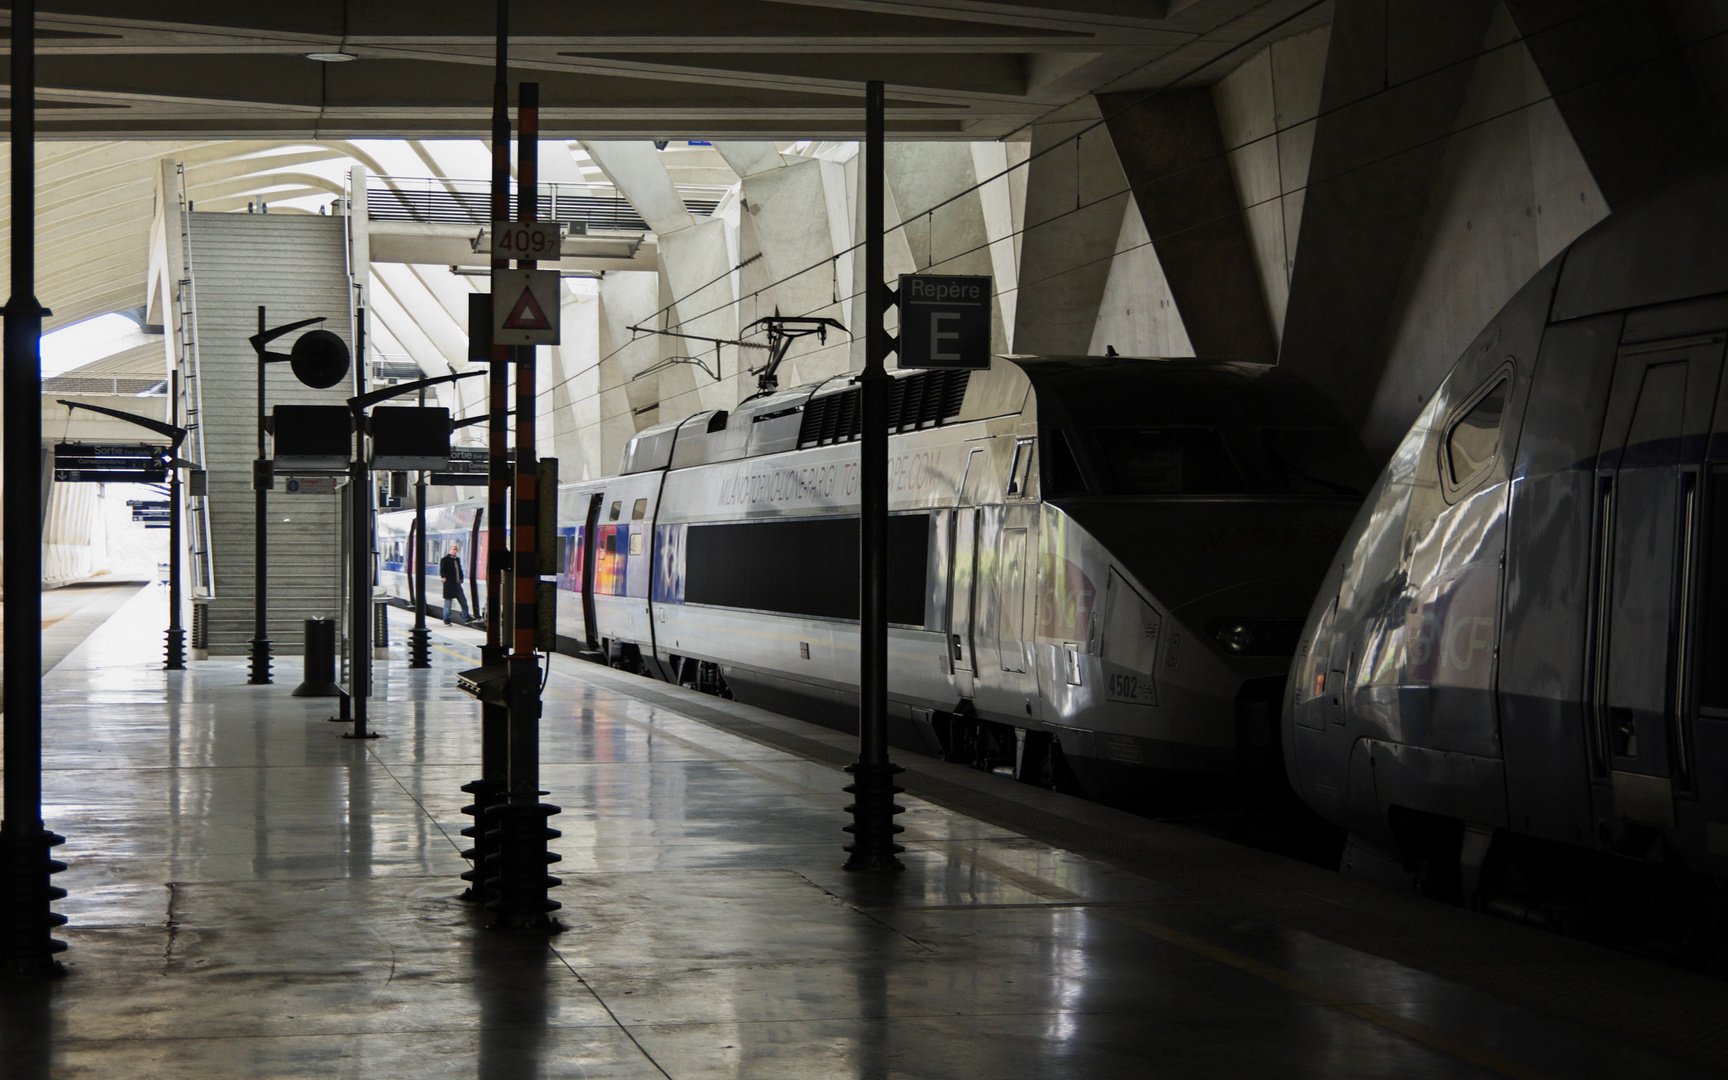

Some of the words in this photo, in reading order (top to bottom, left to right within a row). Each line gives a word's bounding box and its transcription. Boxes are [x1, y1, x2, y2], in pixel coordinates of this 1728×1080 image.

[911, 279, 981, 301] Repère
[930, 311, 961, 361] E
[94, 445, 123, 455] Sortie
[450, 451, 473, 460] ortie
[1041, 588, 1093, 629] SNCF
[1109, 673, 1138, 699] 4502
